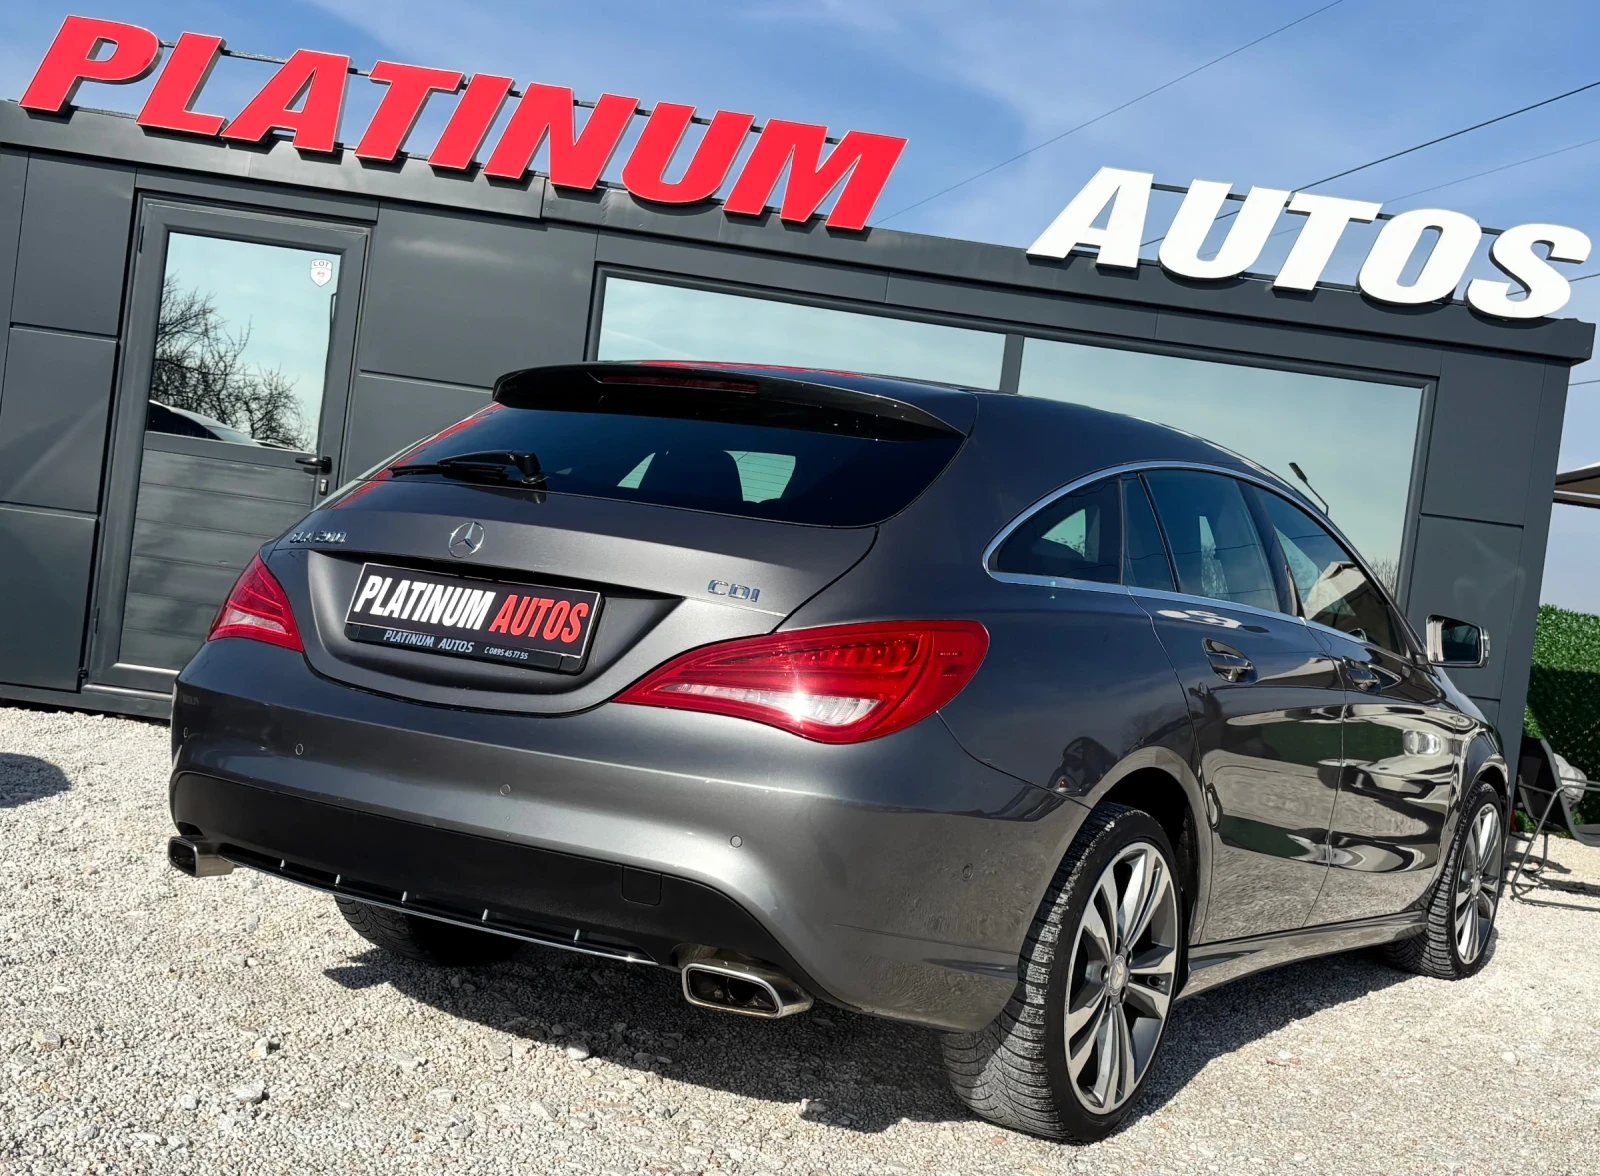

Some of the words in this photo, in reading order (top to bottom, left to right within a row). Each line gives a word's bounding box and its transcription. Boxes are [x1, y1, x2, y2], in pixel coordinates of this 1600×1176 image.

[18, 14, 908, 231] PLATINUM
[1026, 166, 1592, 319] AUTOS
[353, 575, 497, 631] PLATINUM
[488, 594, 590, 644] AUTOS
[708, 580, 760, 602] CDI
[383, 630, 435, 647] PLATINUM
[437, 638, 475, 653] AUTOS
